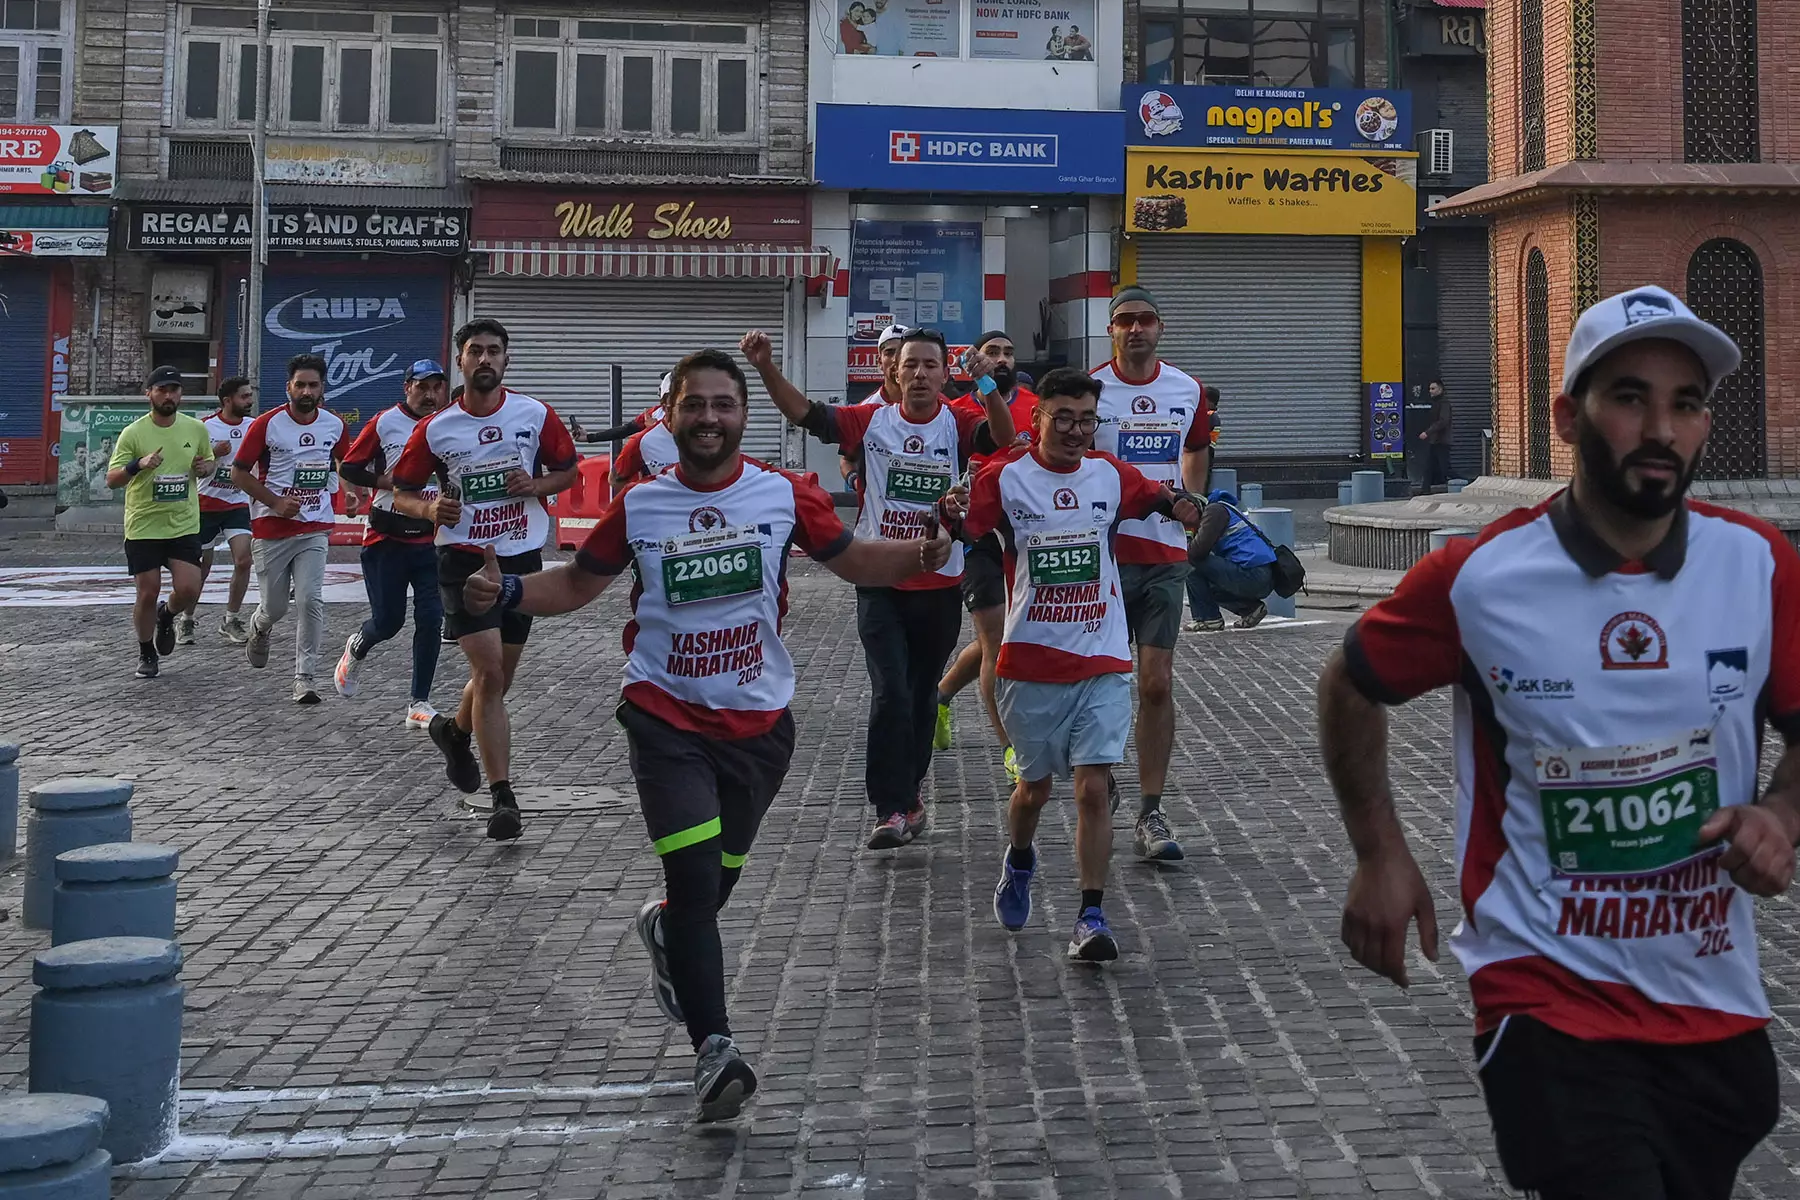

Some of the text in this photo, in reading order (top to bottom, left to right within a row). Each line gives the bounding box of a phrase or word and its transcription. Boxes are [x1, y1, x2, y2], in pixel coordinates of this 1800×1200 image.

[976, 9, 1071, 21] NOW AT HDFC BANK
[1236, 89, 1297, 98] DELHI KE MASHOOR
[1206, 101, 1333, 134] nagpal's
[0, 140, 42, 158] RE
[927, 140, 1047, 158] HDFC BANK
[1208, 136, 1235, 144] SPECIAL
[1289, 138, 1314, 146] PANEER
[1315, 138, 1333, 146] WALE
[16, 167, 33, 175] ARTS,
[1058, 175, 1077, 183] Ganta
[1080, 175, 1094, 183] Ghar
[1146, 164, 1384, 193] Kashir Waffles
[1227, 197, 1261, 206] Waffles
[1268, 198, 1275, 206] &
[142, 212, 460, 236] REGAL ATS AND CRAFTS
[554, 200, 732, 240] Walk Shoes
[141, 236, 165, 245] DEALS
[167, 237, 177, 245] IN:
[179, 237, 193, 245] ALL
[194, 237, 217, 245] KINDS
[218, 237, 228, 245] OF
[281, 237, 303, 246] ITEMS
[305, 237, 321, 246] LIKE
[323, 238, 354, 247] SHAWLS,
[356, 238, 384, 247] STOLES,
[386, 239, 420, 248] PONCHUS,
[422, 239, 460, 247] SWEATERS
[301, 297, 406, 320] RUPA
[169, 321, 195, 329] STAIRS
[1125, 435, 1172, 449] 42087
[299, 470, 326, 481] 21258
[469, 473, 508, 491] 2151
[894, 473, 942, 490] 25132
[157, 483, 185, 494] 21305
[473, 501, 526, 525] KASHMI
[880, 523, 925, 540] MARAT
[673, 551, 748, 582] 22066
[1037, 548, 1092, 569] 25152
[1033, 583, 1101, 605] KASHMIR
[1026, 602, 1107, 622] MARATHON
[671, 621, 759, 657] KASHMIR
[666, 639, 764, 679] MARATHON
[1513, 679, 1575, 693] J&K Bank
[1580, 753, 1659, 771] KASHMIR MARATHON
[1564, 780, 1697, 834] 21062
[1556, 886, 1736, 939] MARATHON
